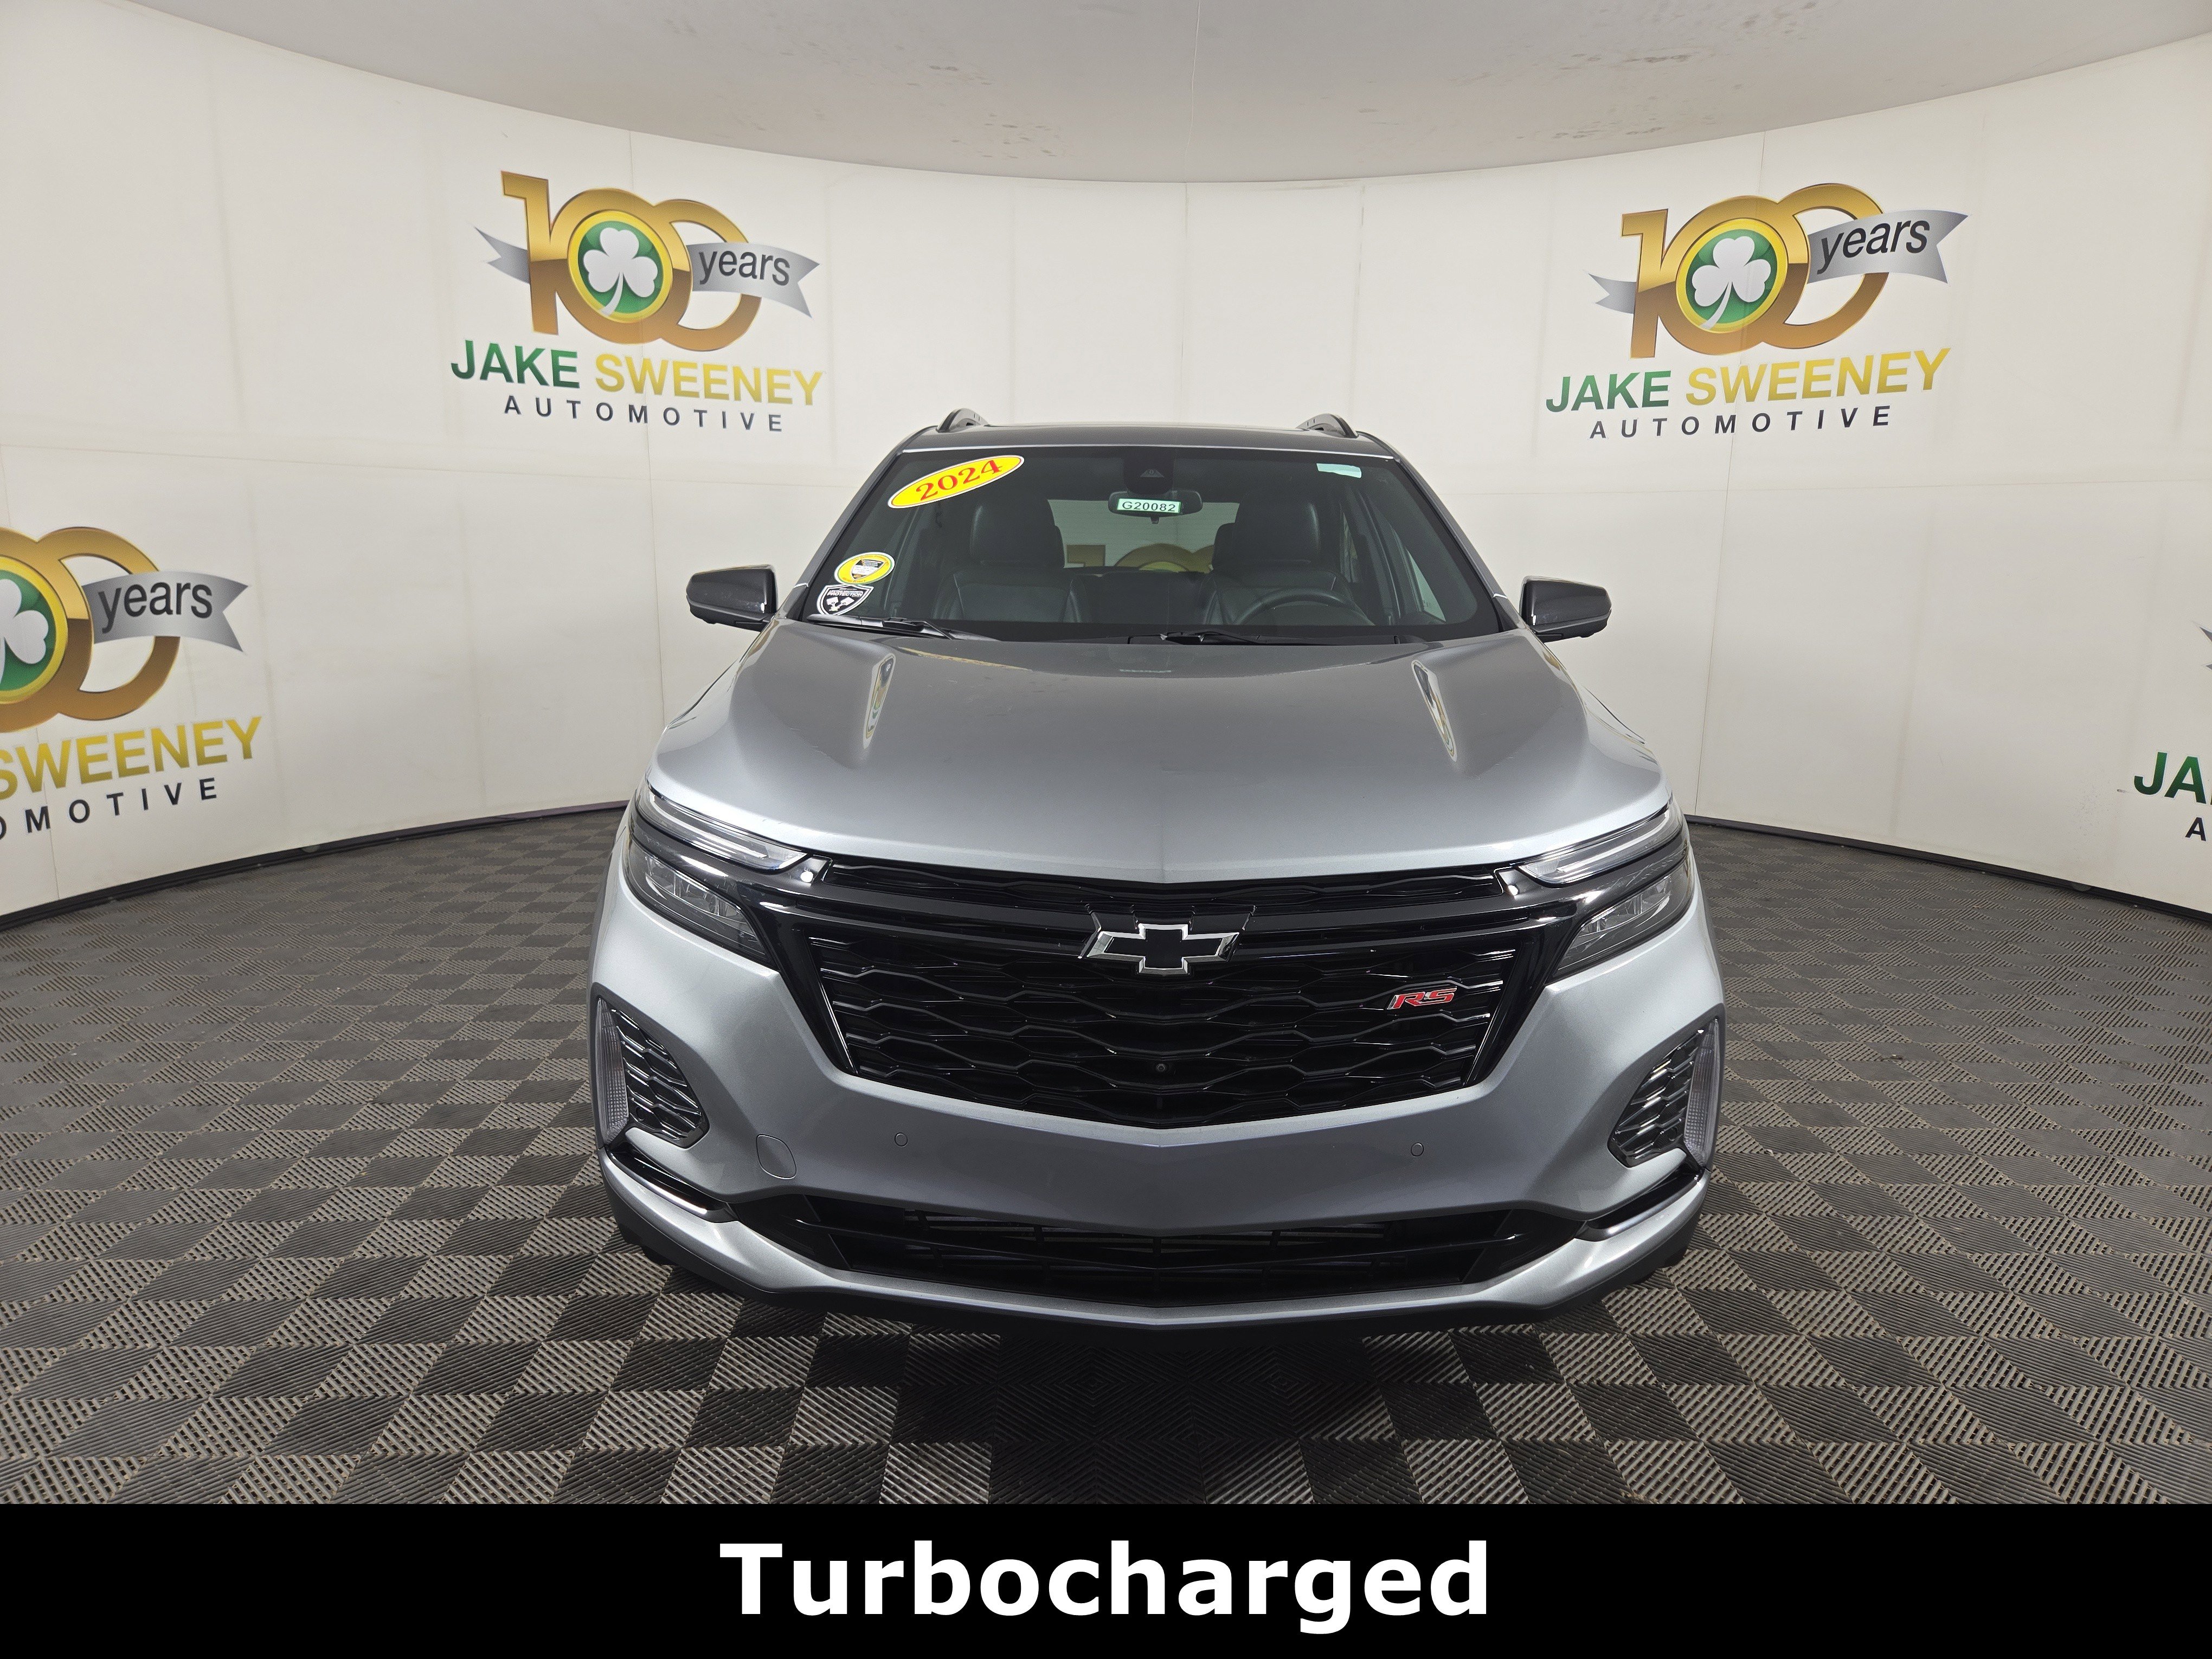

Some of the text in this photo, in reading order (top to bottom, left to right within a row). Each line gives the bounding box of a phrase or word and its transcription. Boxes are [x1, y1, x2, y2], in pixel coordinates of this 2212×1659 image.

[698, 248, 791, 286] years
[1816, 219, 1930, 275] years
[451, 339, 822, 406] JAKE SWEENEY
[1546, 347, 1951, 413] JAKE SWEENEY
[504, 395, 782, 432] AUTOMOTIVE
[1589, 406, 1891, 439] AUTOMOTIVE
[915, 459, 1003, 501] 2024
[1122, 501, 1176, 511] G20082
[98, 582, 213, 634] years
[2133, 751, 2212, 806] JA
[1387, 987, 1457, 1009] RS
